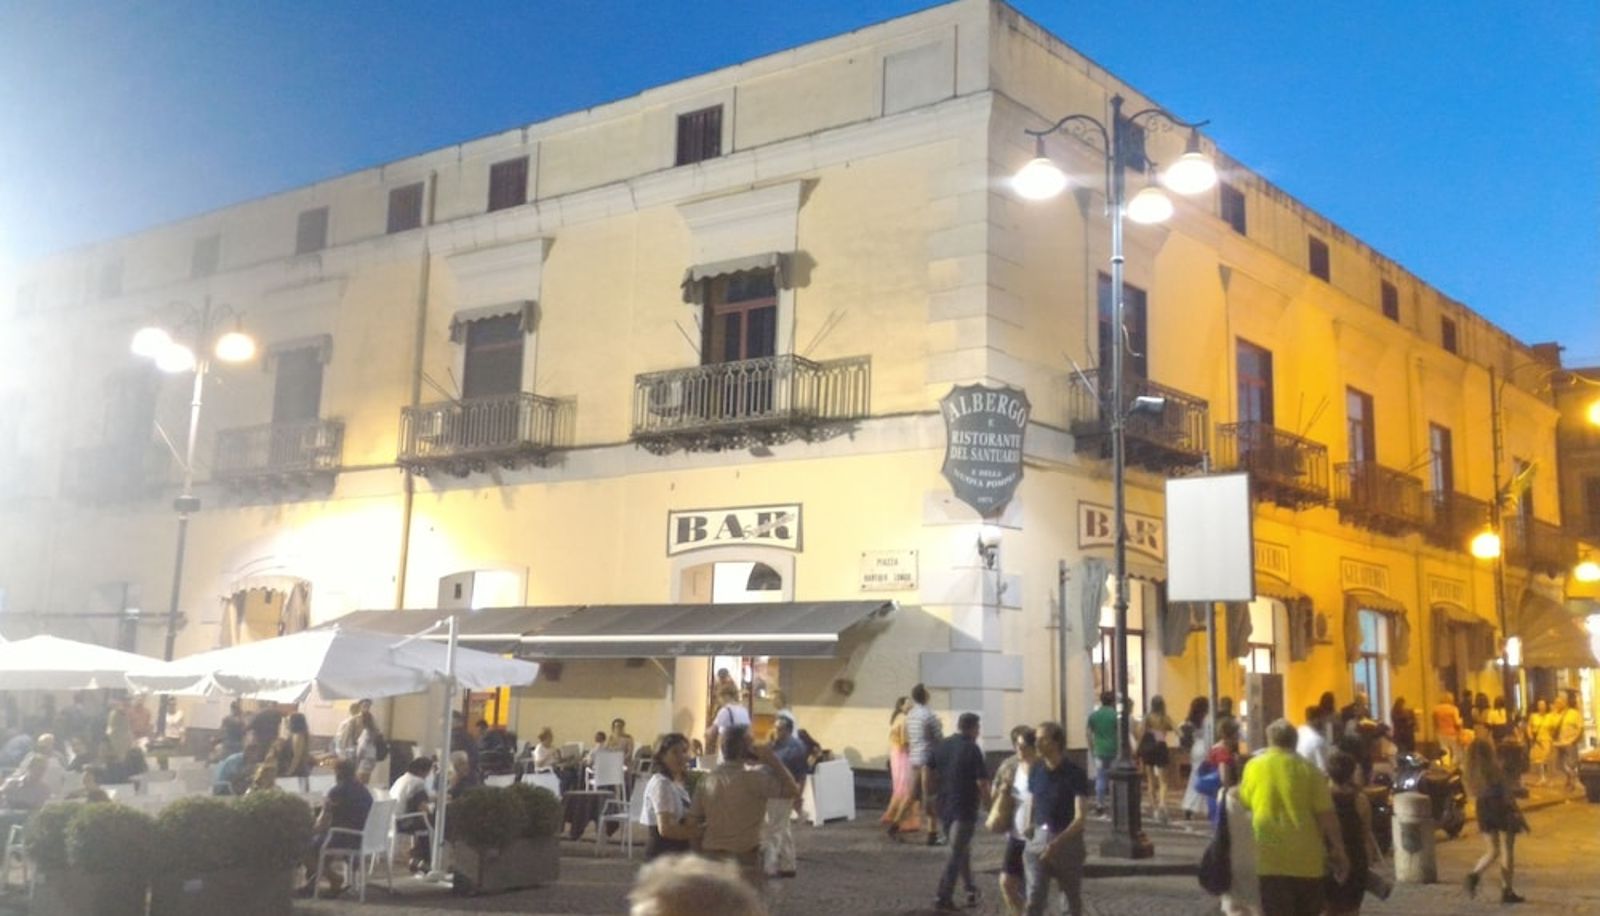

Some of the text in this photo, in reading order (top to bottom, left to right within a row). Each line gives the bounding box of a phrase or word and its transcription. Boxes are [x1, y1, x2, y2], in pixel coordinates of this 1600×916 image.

[949, 392, 1025, 428] ALBERGO
[951, 430, 1021, 449] RISTORANTE
[950, 446, 969, 460] DEL
[675, 511, 793, 545] BAR
